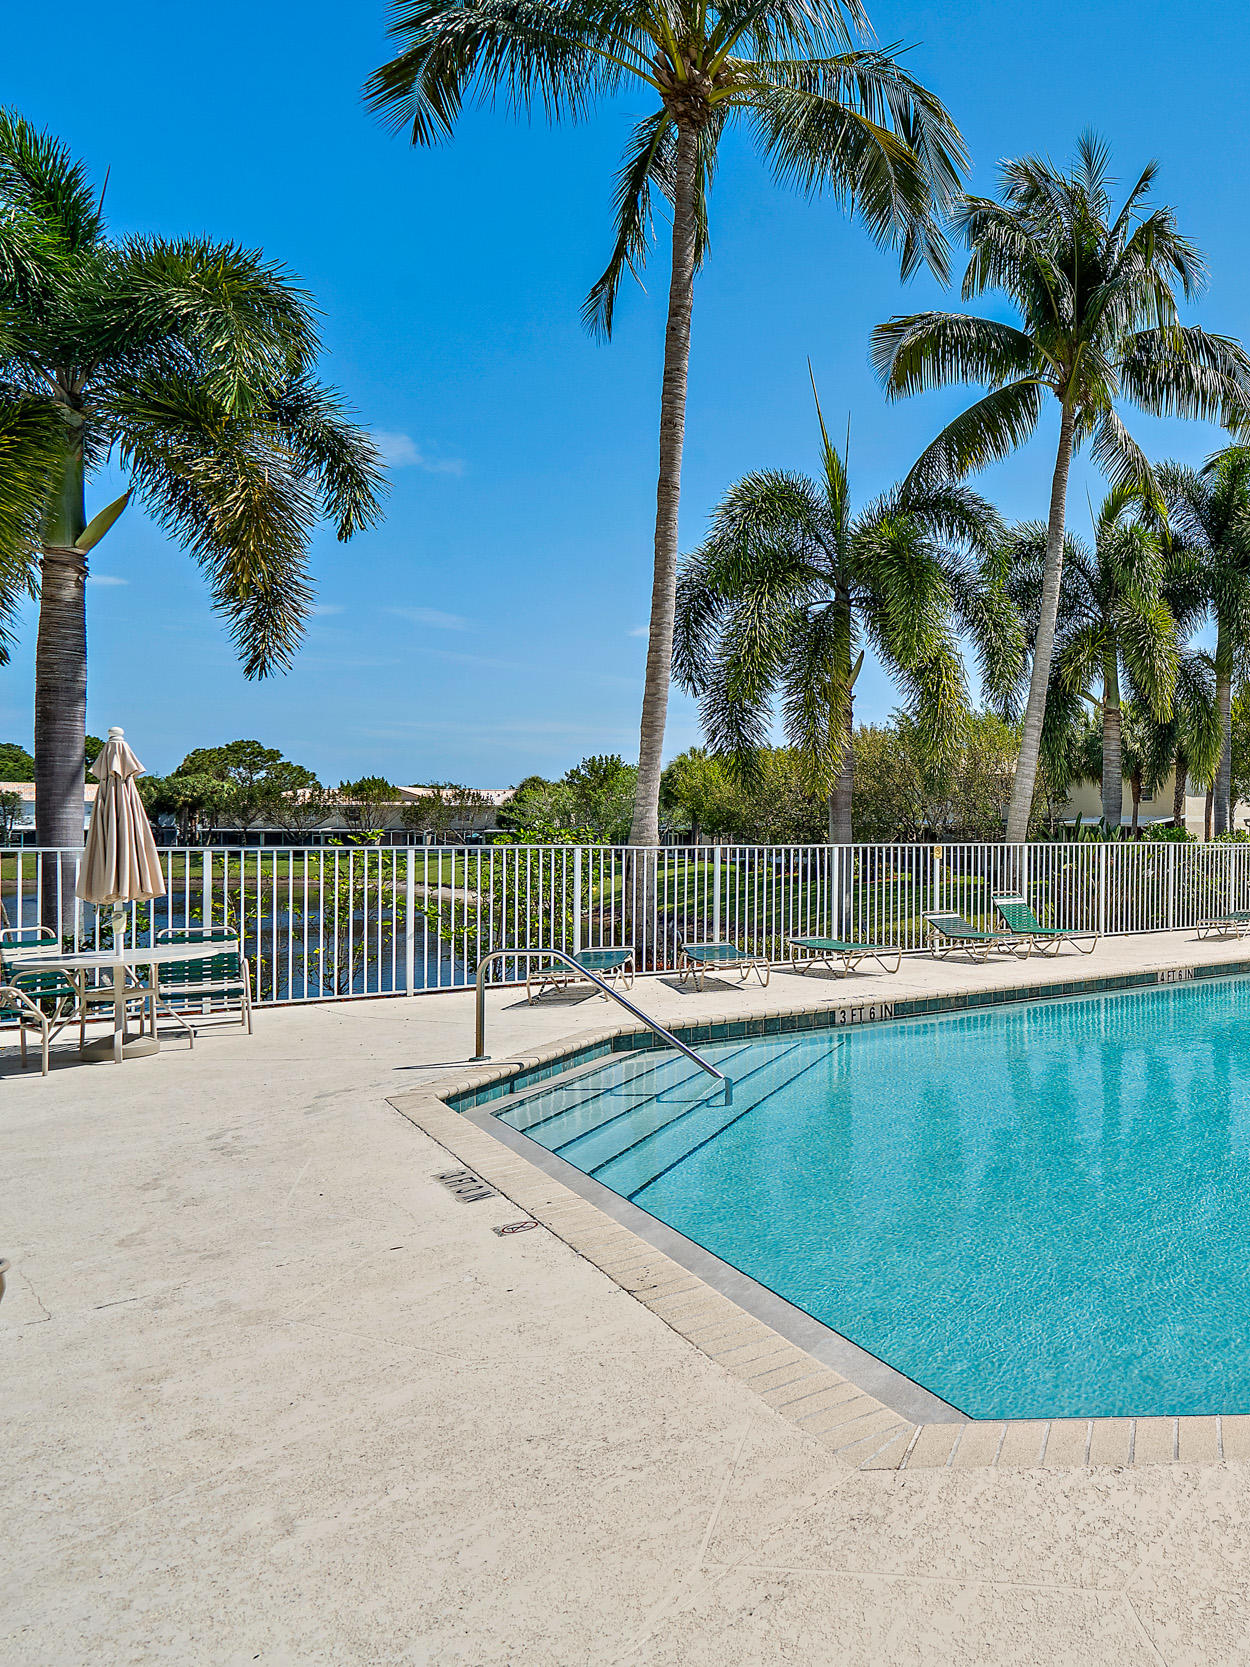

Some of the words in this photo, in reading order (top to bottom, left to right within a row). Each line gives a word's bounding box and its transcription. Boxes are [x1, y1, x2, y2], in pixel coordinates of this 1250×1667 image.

[1167, 970, 1176, 981] FT
[1184, 968, 1193, 979] IN
[840, 1009, 847, 1024] 3
[851, 1007, 864, 1023] FT
[869, 1006, 876, 1020] 6
[880, 1003, 893, 1019] IN
[445, 1177, 478, 1187] FT
[462, 1191, 495, 1203] IN
